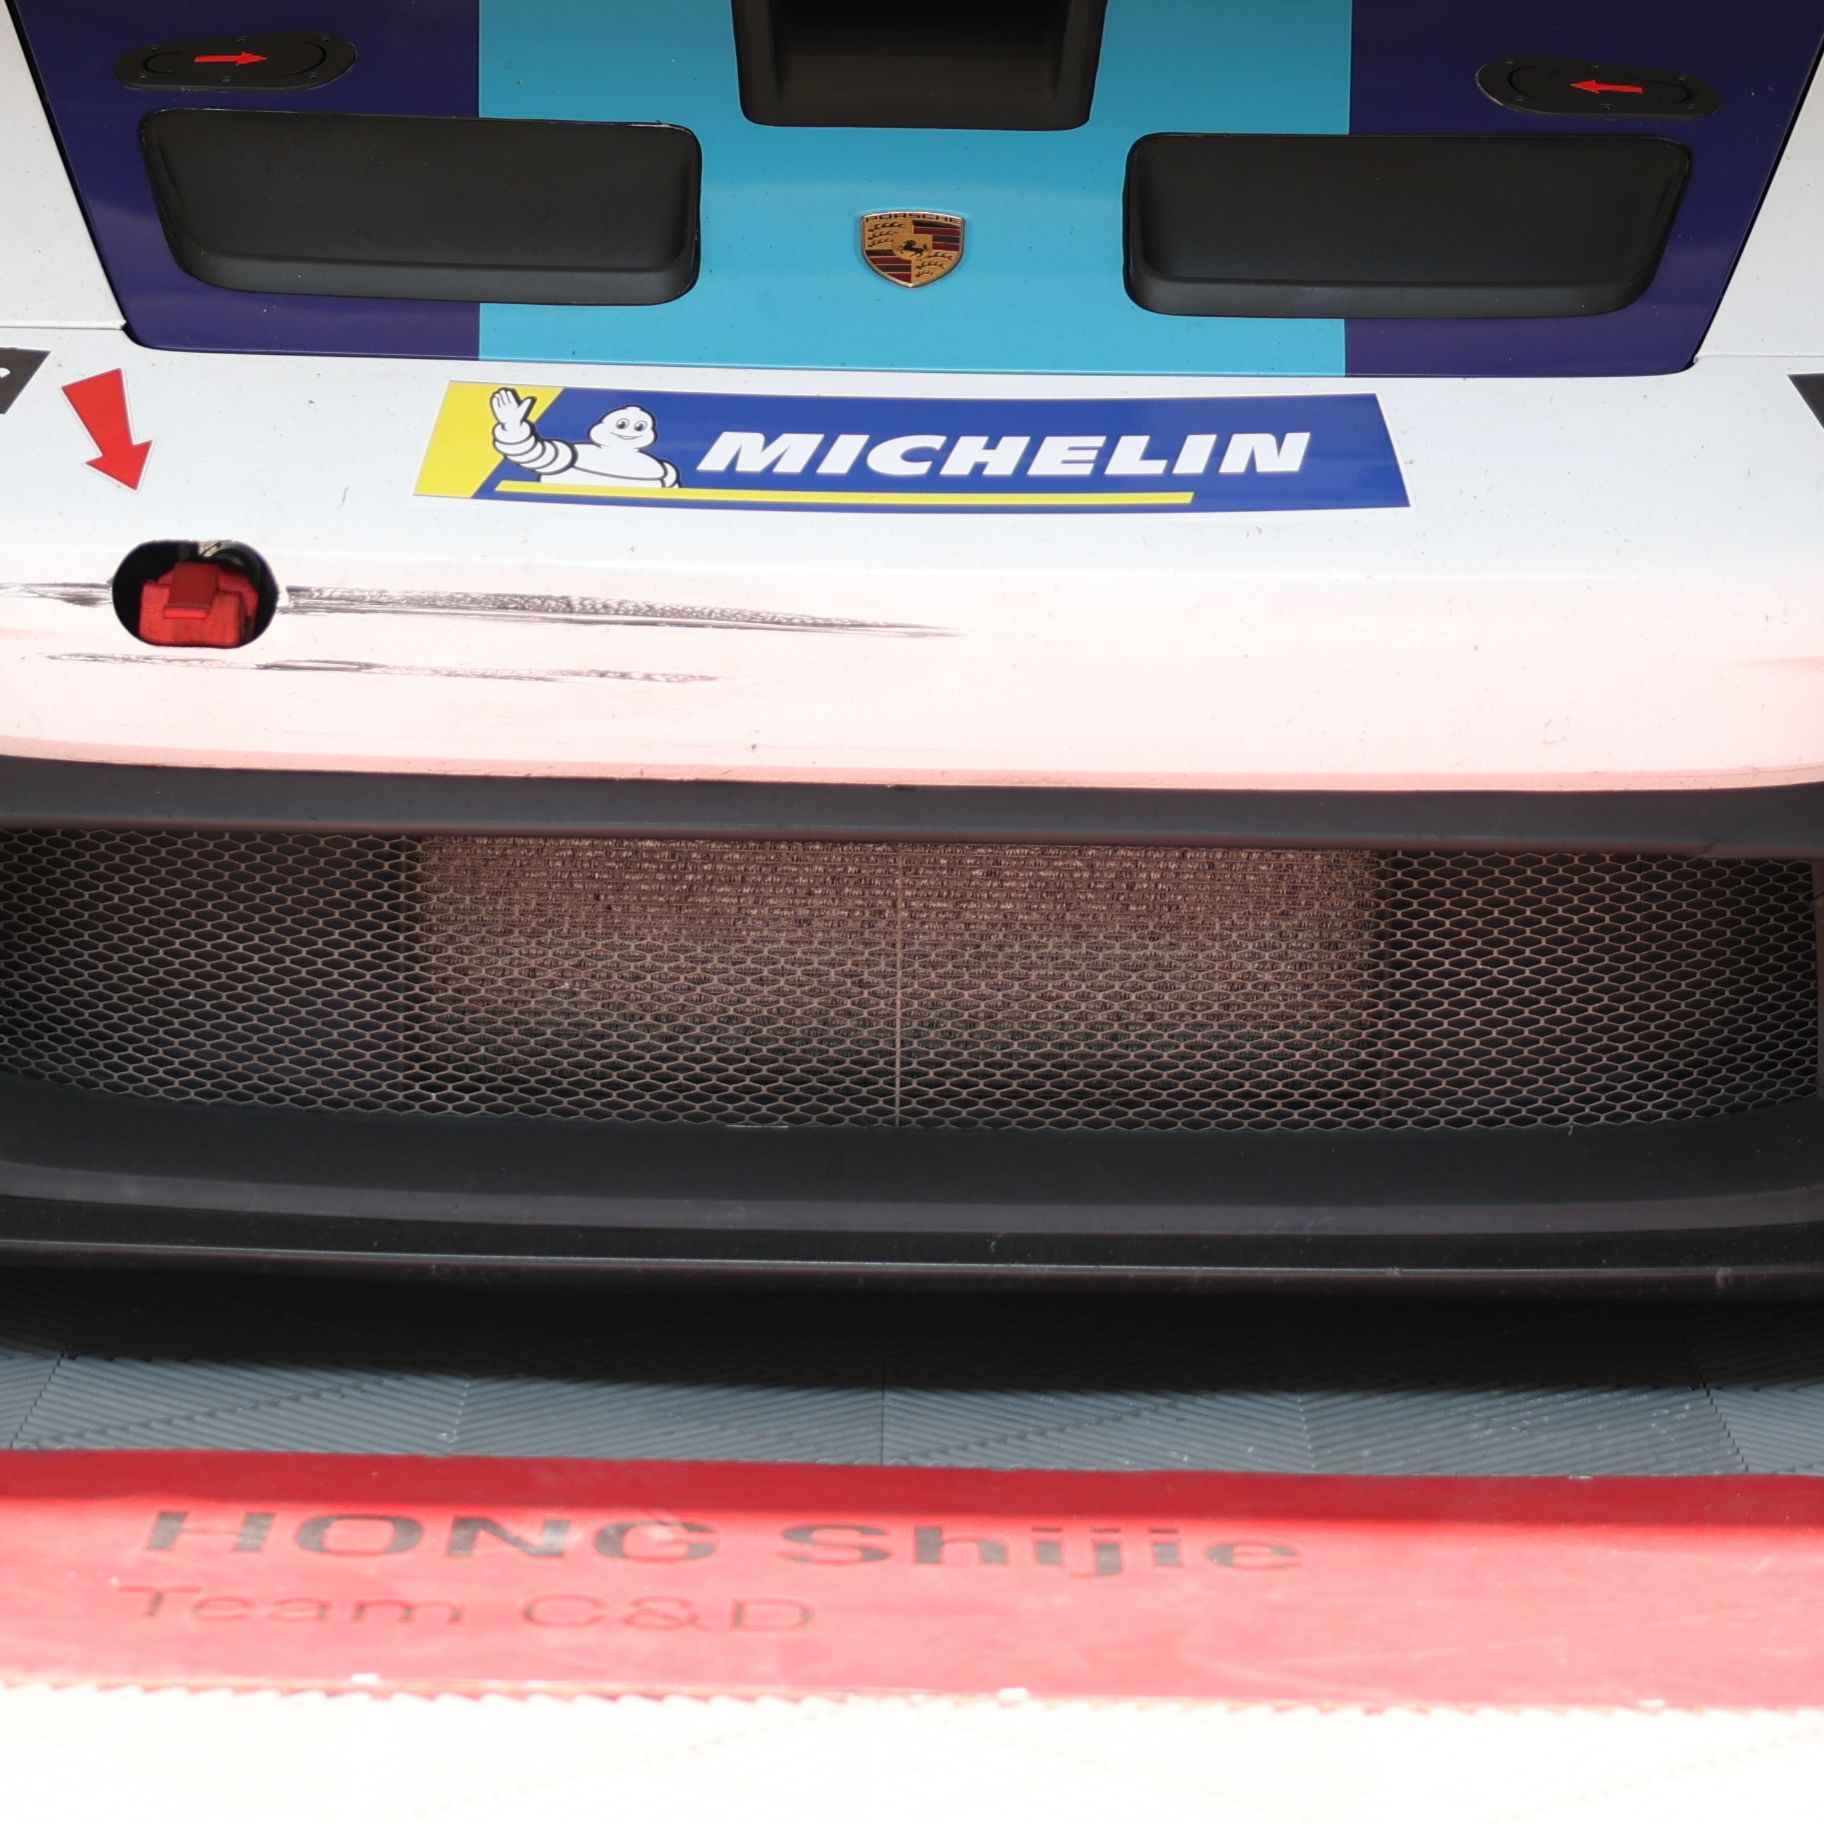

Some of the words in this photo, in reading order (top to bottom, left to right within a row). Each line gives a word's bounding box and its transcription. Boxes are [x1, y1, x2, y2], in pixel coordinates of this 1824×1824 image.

[865, 212, 962, 225] PORSCHE
[695, 430, 1312, 477] MICHELIN
[143, 1510, 719, 1565] HONG
[776, 1523, 1303, 1578] Shijie
[115, 1584, 466, 1624] Team
[522, 1592, 816, 1634] C&D
